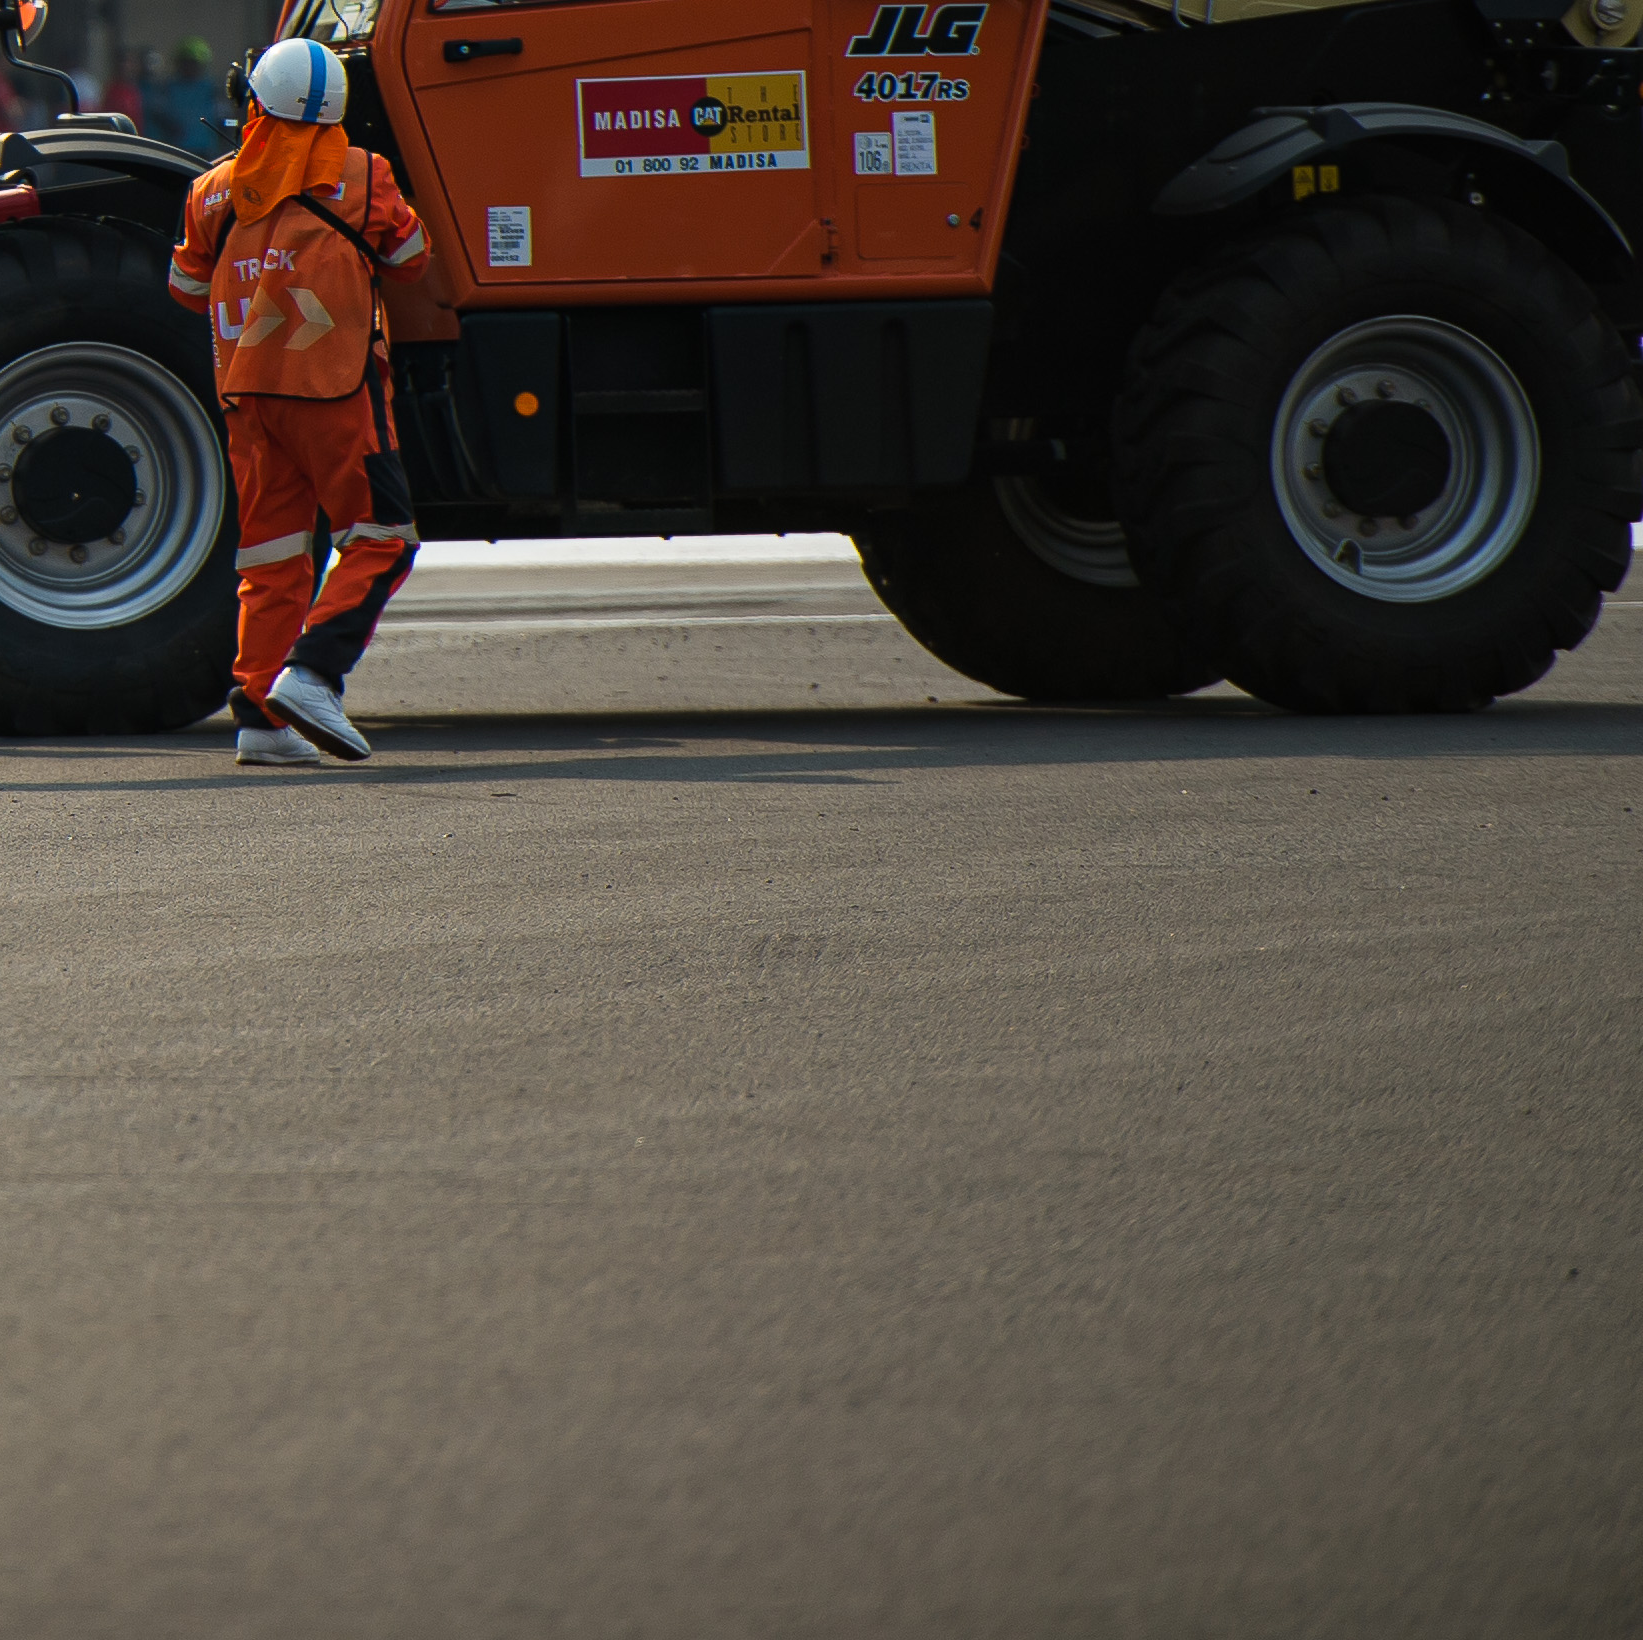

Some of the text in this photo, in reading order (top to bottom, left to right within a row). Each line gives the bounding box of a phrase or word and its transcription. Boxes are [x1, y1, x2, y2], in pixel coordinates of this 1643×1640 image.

[845, 3, 989, 57] JLG
[727, 83, 799, 104] THE
[854, 71, 971, 102] 4017RS
[594, 104, 801, 131] MADISA CAT Rental
[730, 122, 801, 144] STORE
[616, 153, 778, 173] 01 800 92 MADISA
[859, 150, 882, 172] 106
[234, 248, 297, 282] TRCK
